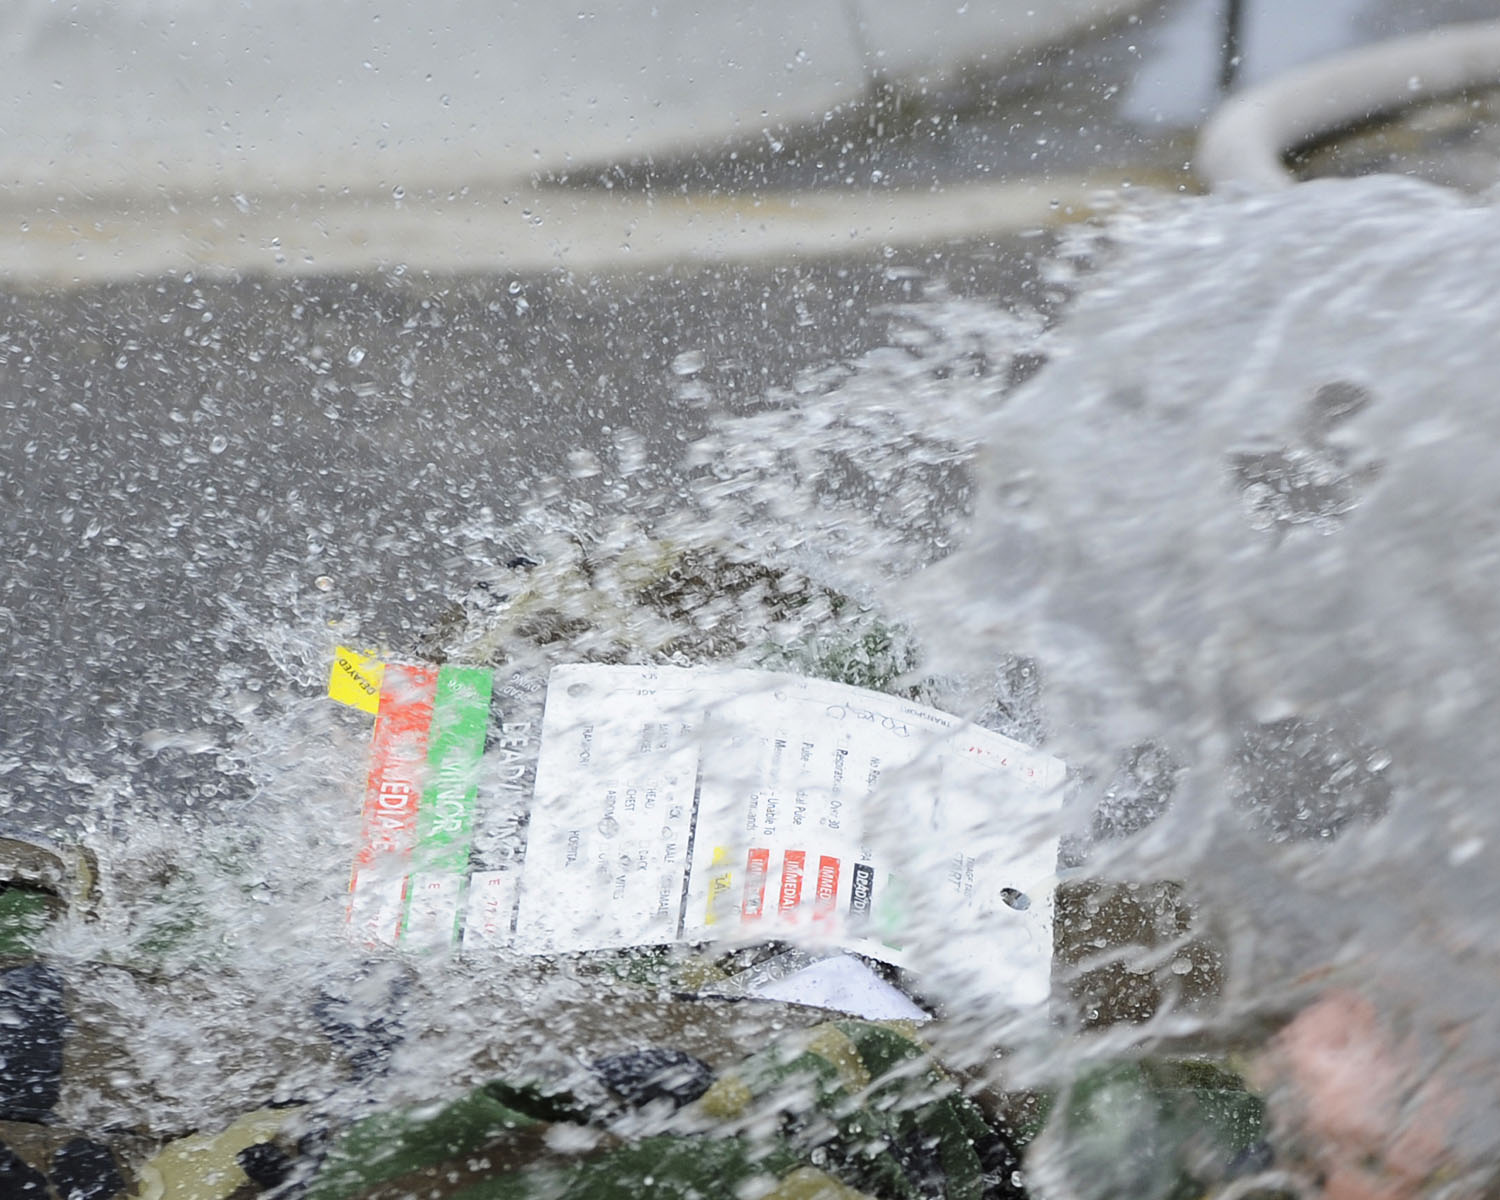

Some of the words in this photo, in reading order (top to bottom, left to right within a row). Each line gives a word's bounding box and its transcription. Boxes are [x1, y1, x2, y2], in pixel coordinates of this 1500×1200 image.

[624, 788, 638, 812] CHEST
[793, 806, 807, 826] Pulse
[779, 860, 800, 913] IMMEDIAT
